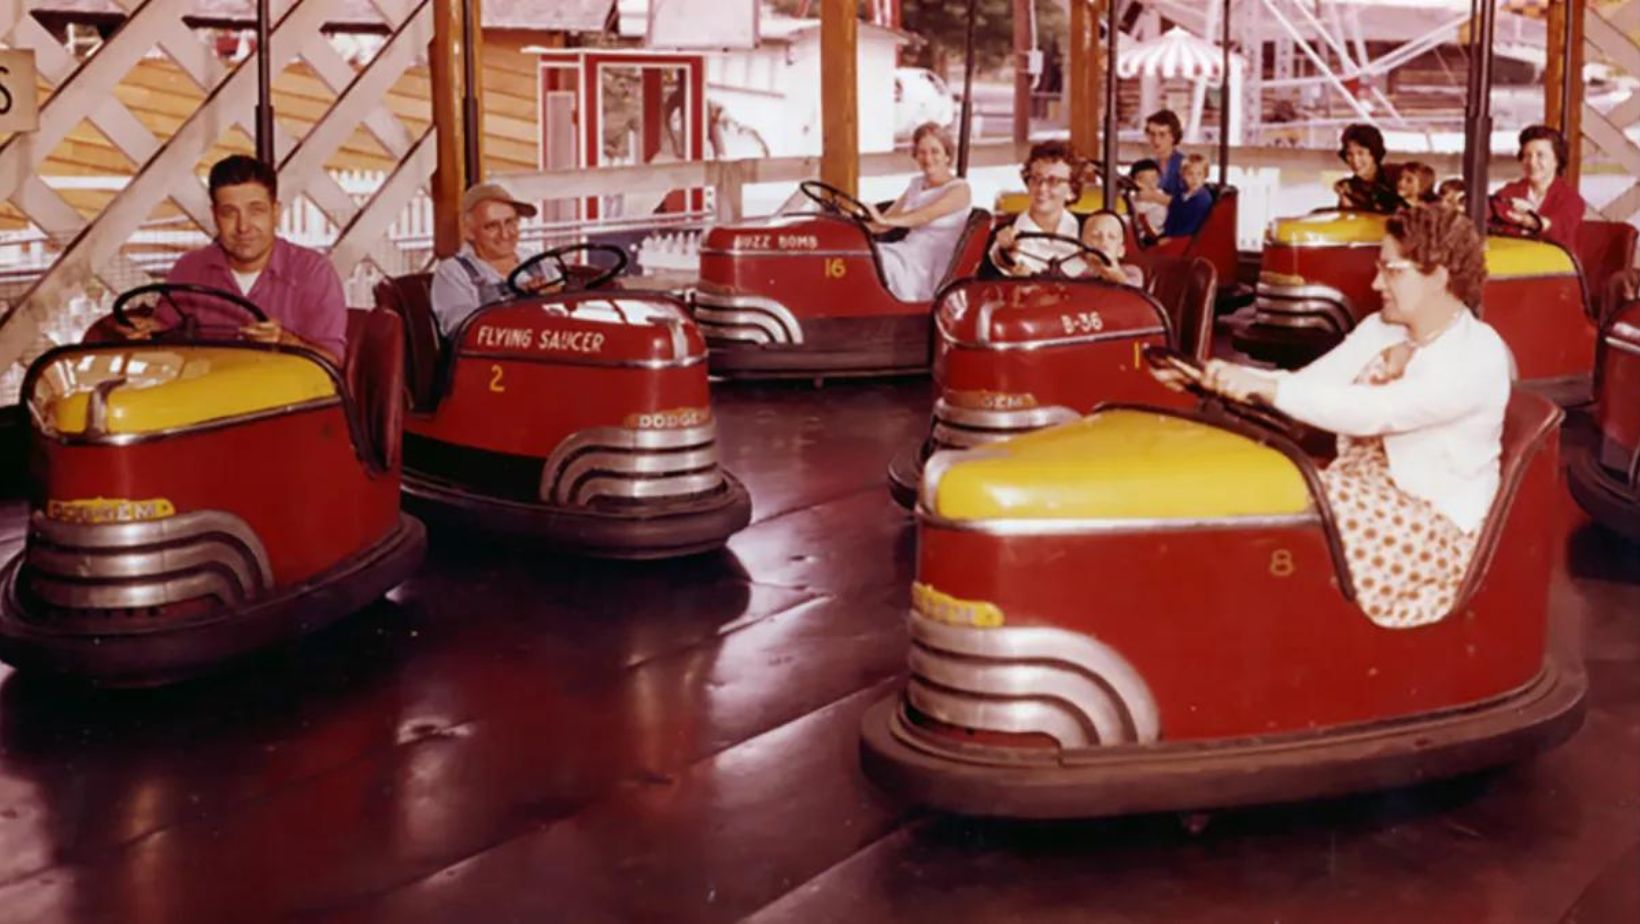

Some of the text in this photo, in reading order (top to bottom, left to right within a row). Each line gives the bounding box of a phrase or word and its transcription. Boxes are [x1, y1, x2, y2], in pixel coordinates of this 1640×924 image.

[734, 234, 818, 250] BUZZ BOMB
[825, 257, 846, 278] 16
[1061, 311, 1103, 334] B-36
[477, 325, 605, 352] FLYING SAUCER
[489, 363, 505, 392] 2
[1270, 549, 1294, 577] 8
